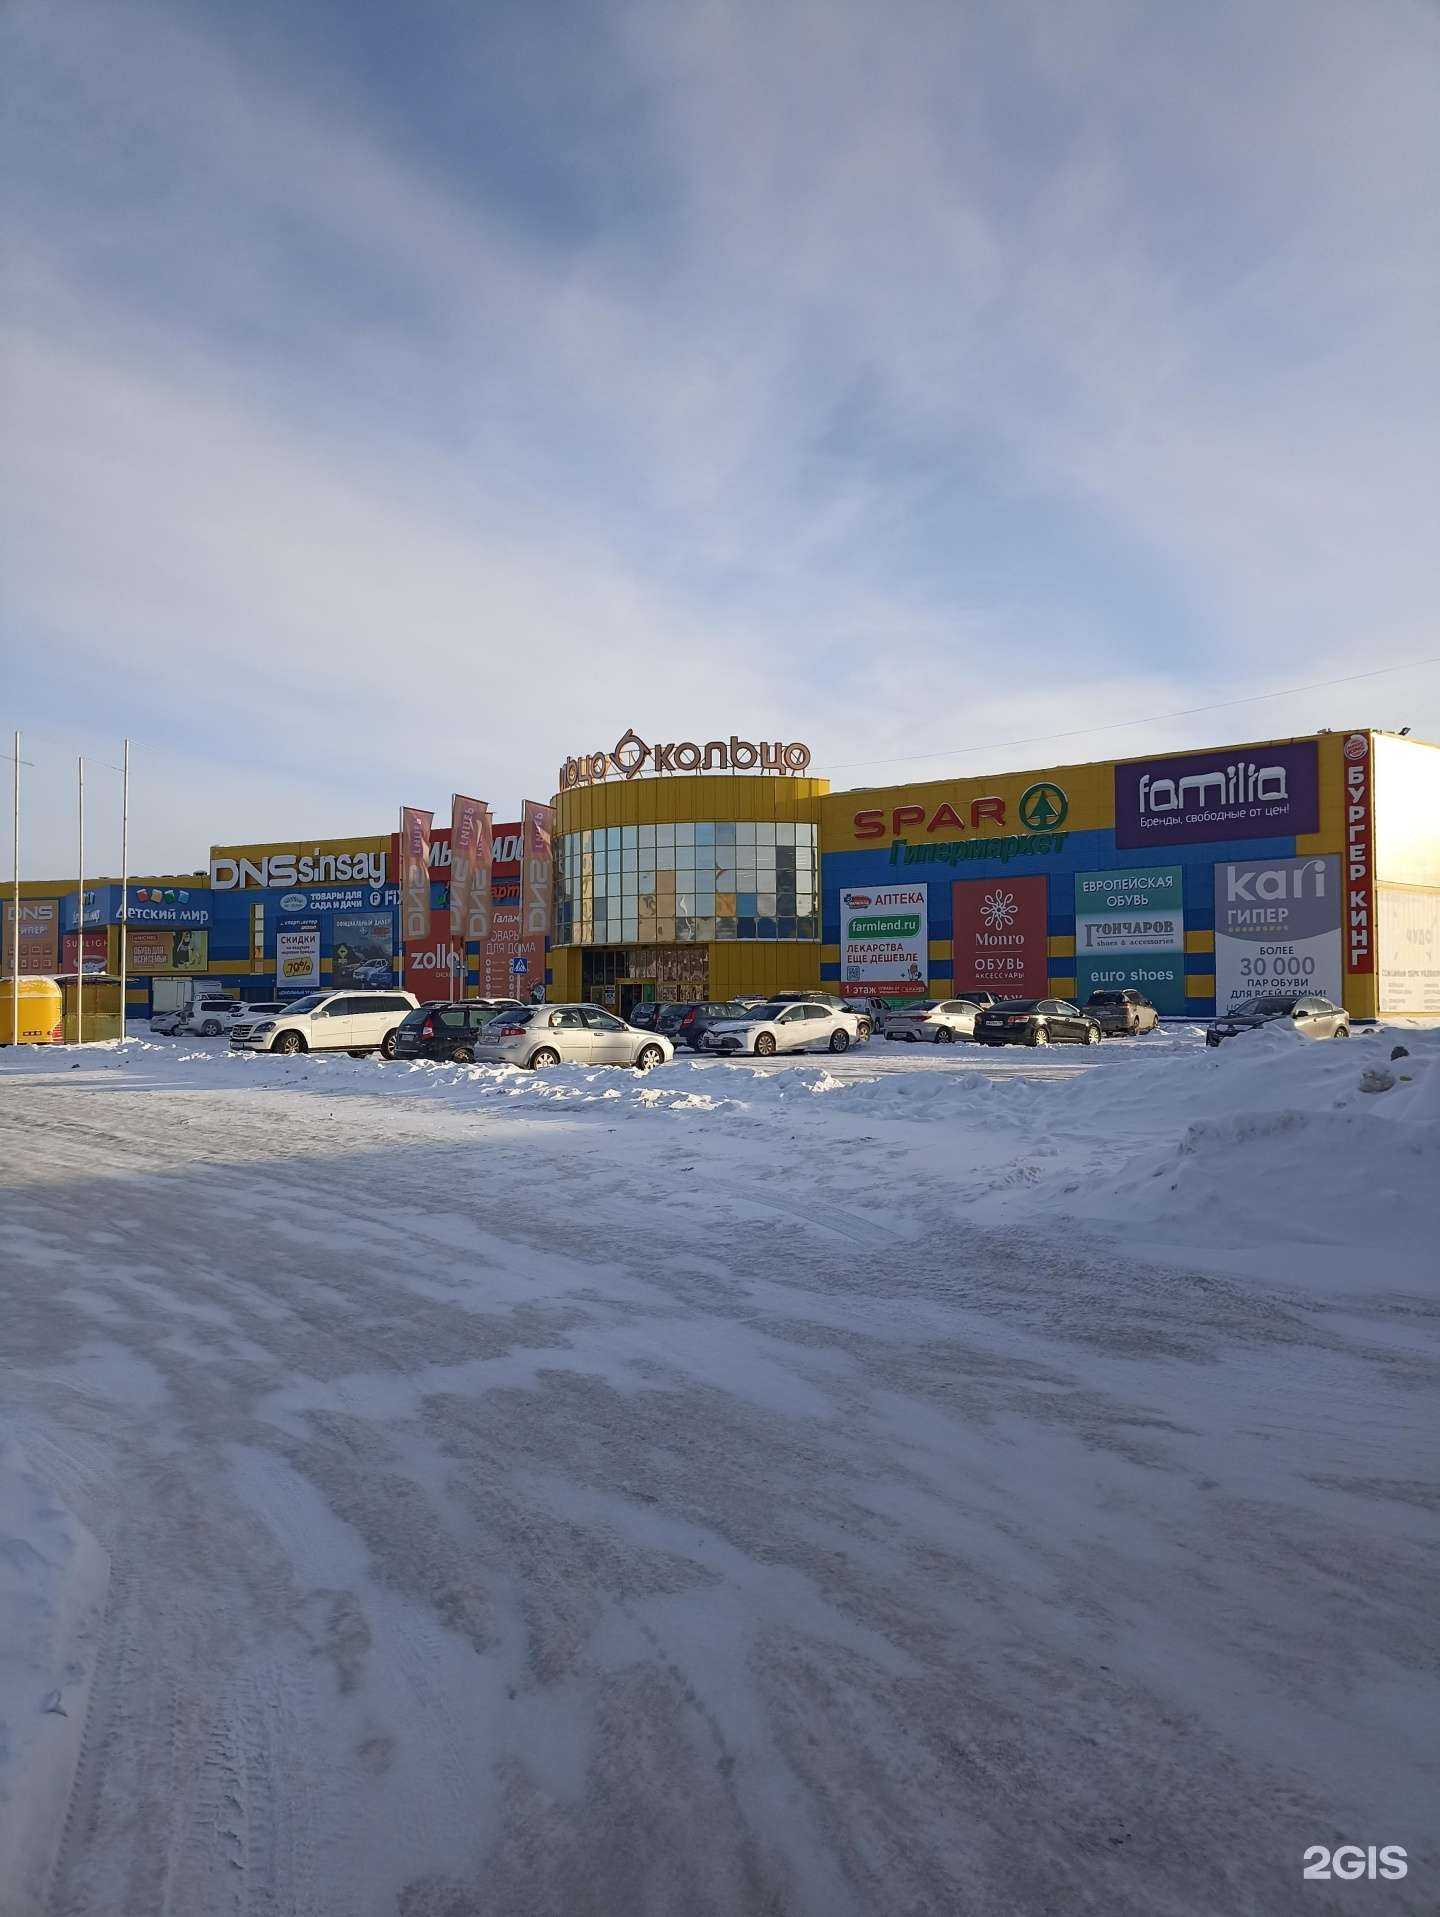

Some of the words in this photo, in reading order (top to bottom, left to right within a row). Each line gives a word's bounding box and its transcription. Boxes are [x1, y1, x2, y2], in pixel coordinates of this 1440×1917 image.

[654, 736, 811, 775] кольцо
[1139, 762, 1288, 813] familia
[853, 795, 1006, 839] SPAR
[1140, 817, 1183, 828] Бренды,
[1185, 808, 1246, 823] свободные
[1250, 806, 1261, 817] от
[1265, 803, 1289, 817] цен!
[1347, 765, 1366, 881] БУРГЕР
[889, 832, 1069, 867] Гипермаркет
[210, 854, 297, 890] DNS
[298, 848, 387, 889] sinsay
[1083, 876, 1173, 892] ЕВРОПЕЙСКАЯ
[1227, 859, 1326, 902] kari
[310, 892, 344, 900] ТОВАРЫ
[345, 891, 362, 900] ДЛЯ
[875, 892, 925, 906] АПТЕКА
[1107, 895, 1149, 907] ОБУВЬ
[310, 902, 331, 910] САДА
[333, 901, 339, 909] И
[341, 900, 362, 909] ДАЧИ
[8, 905, 52, 920] DNS
[180, 909, 209, 924] мир
[1228, 908, 1288, 925] ГИПЕР
[851, 919, 916, 932] farmlend.ru
[1350, 890, 1369, 967] КИНГ
[280, 935, 316, 945] СКИДКИ
[975, 933, 1025, 946] Monro
[1085, 921, 1174, 947] ГОНЧАРОВ
[486, 943, 505, 955] ДЛЯ
[507, 942, 536, 955] ДОМА
[847, 943, 904, 953] ЛЕКАРСТВА
[1259, 946, 1295, 955] БОЛЕЕ
[847, 954, 868, 965] ЕЩЕ
[870, 953, 919, 965] ДЕШЕВЛЕ
[975, 958, 1024, 970] ОБУВЬ
[1240, 957, 1266, 976] 30
[1273, 956, 1315, 976] 000
[1091, 971, 1125, 982] euro
[1130, 969, 1174, 981] shoes
[1247, 979, 1269, 987] ПАР
[1271, 978, 1308, 987] ОБУВИ
[854, 986, 876, 995] этаж
[1230, 990, 1250, 999] ДЛЯ
[1254, 988, 1282, 997] ВСЕЙ
